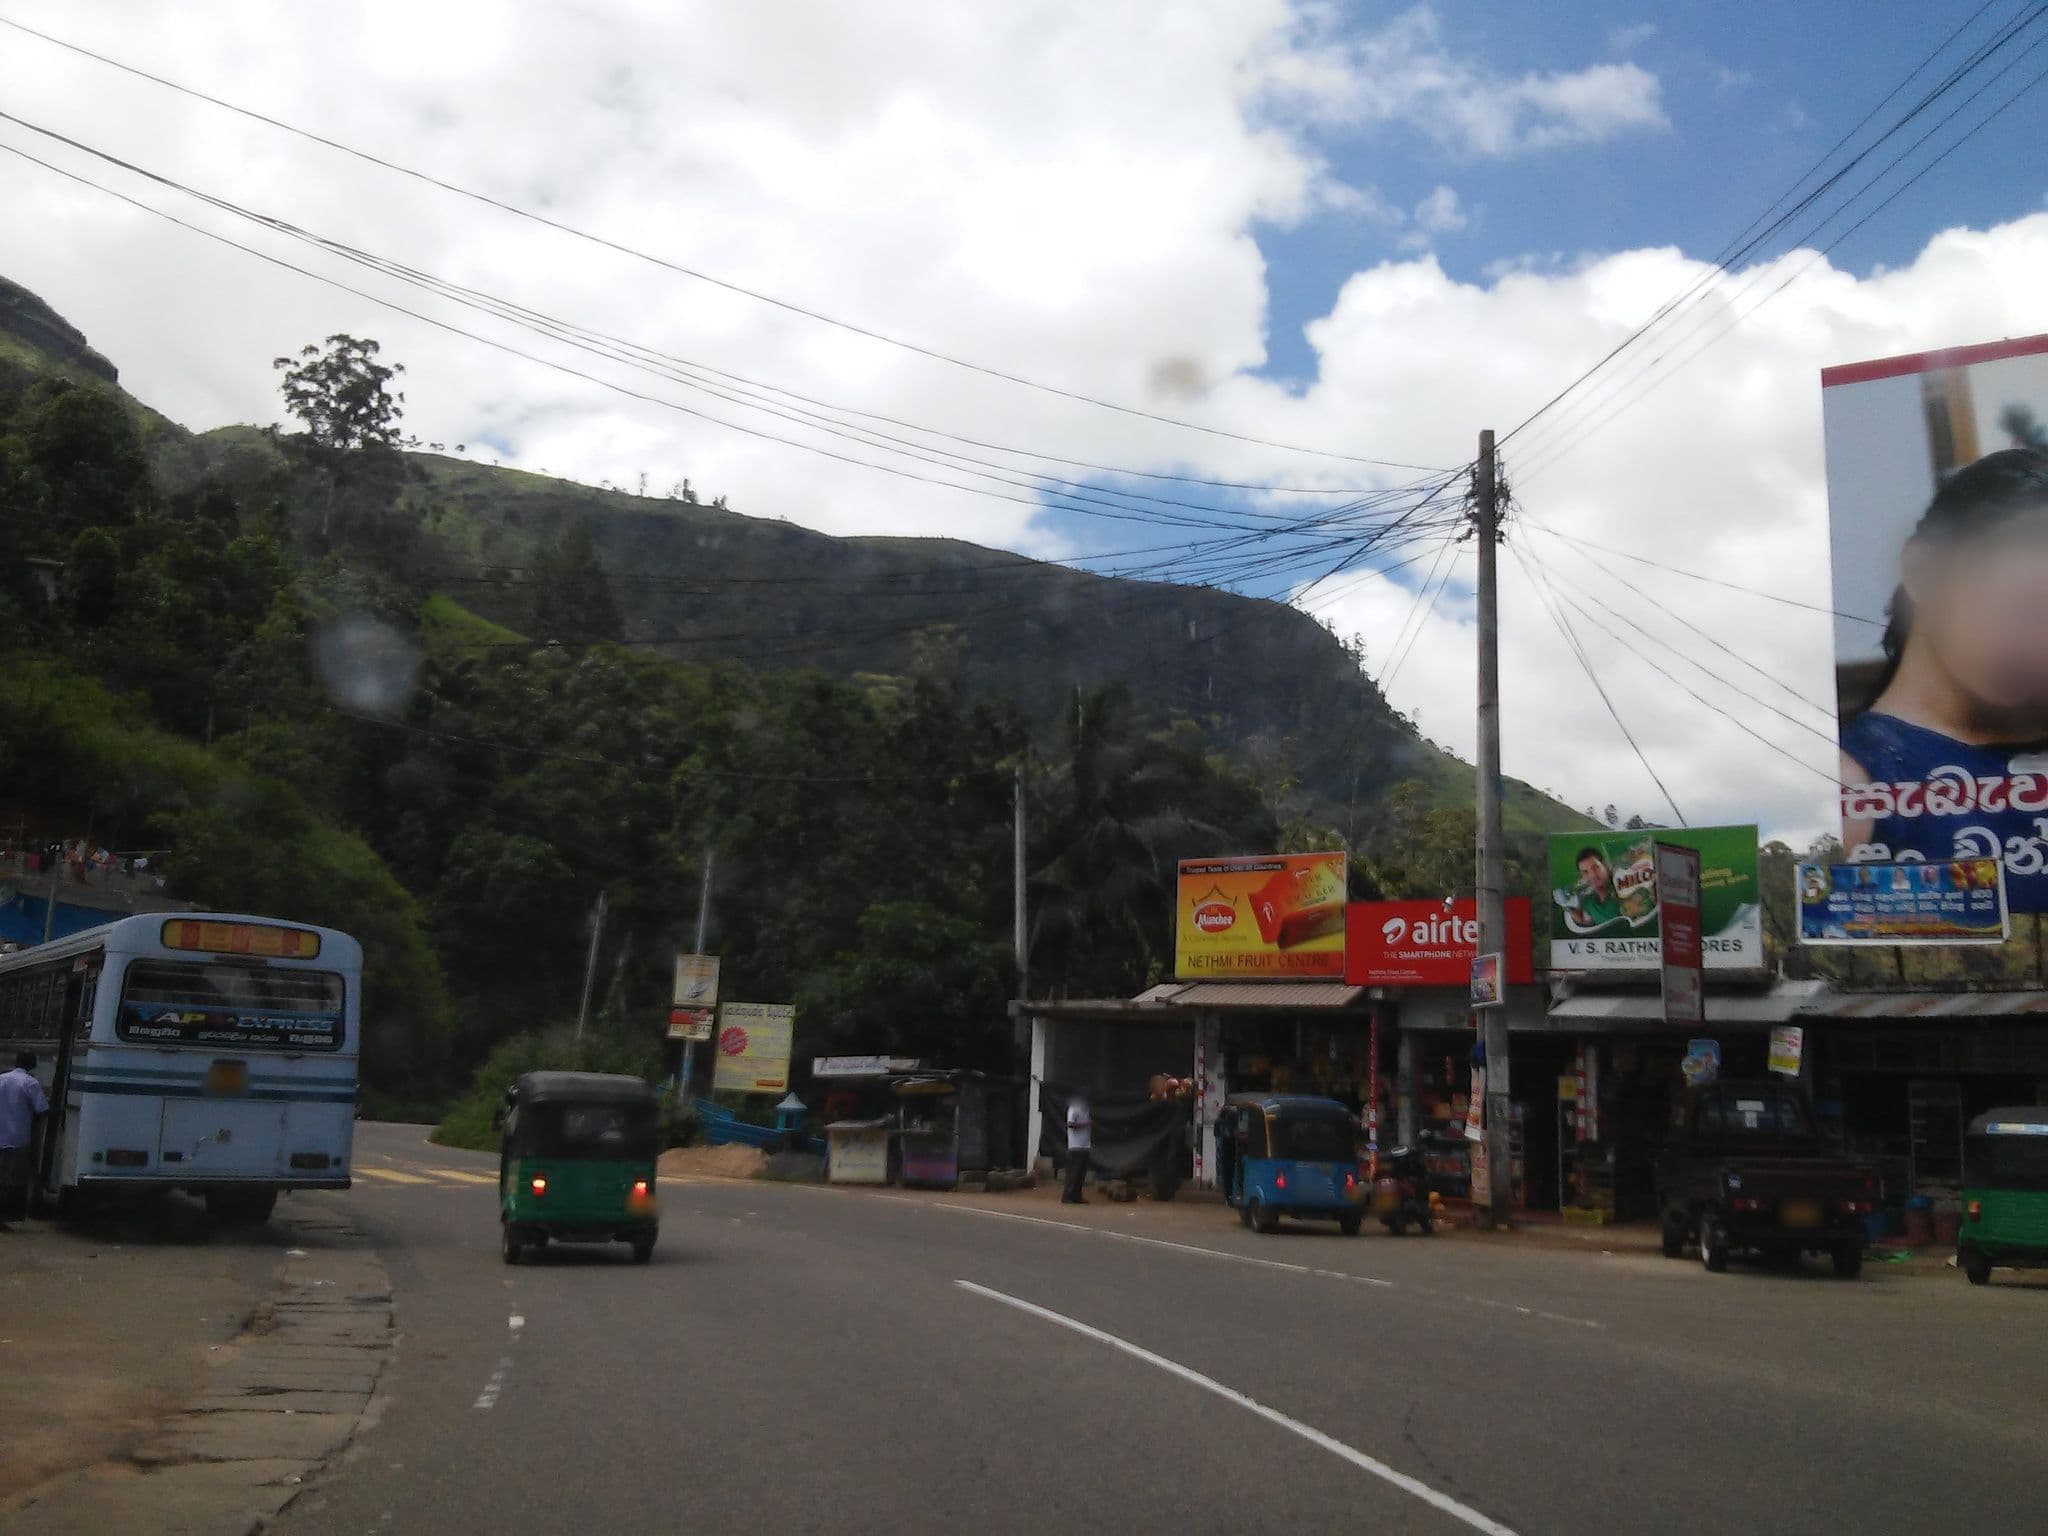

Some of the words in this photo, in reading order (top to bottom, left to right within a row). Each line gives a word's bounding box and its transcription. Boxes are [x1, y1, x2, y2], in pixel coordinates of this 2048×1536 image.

[1412, 912, 1478, 944] airte
[1568, 942, 1581, 954] V.
[1585, 941, 1599, 954] S.
[1604, 940, 1659, 954] RATHN
[1701, 938, 1743, 952] ORES
[1188, 954, 1232, 968] NETHMI
[1237, 954, 1271, 968] FRUIT
[1383, 951, 1397, 959] THE
[1398, 950, 1452, 959] SMARTPHONE
[1452, 950, 1477, 958] NETW
